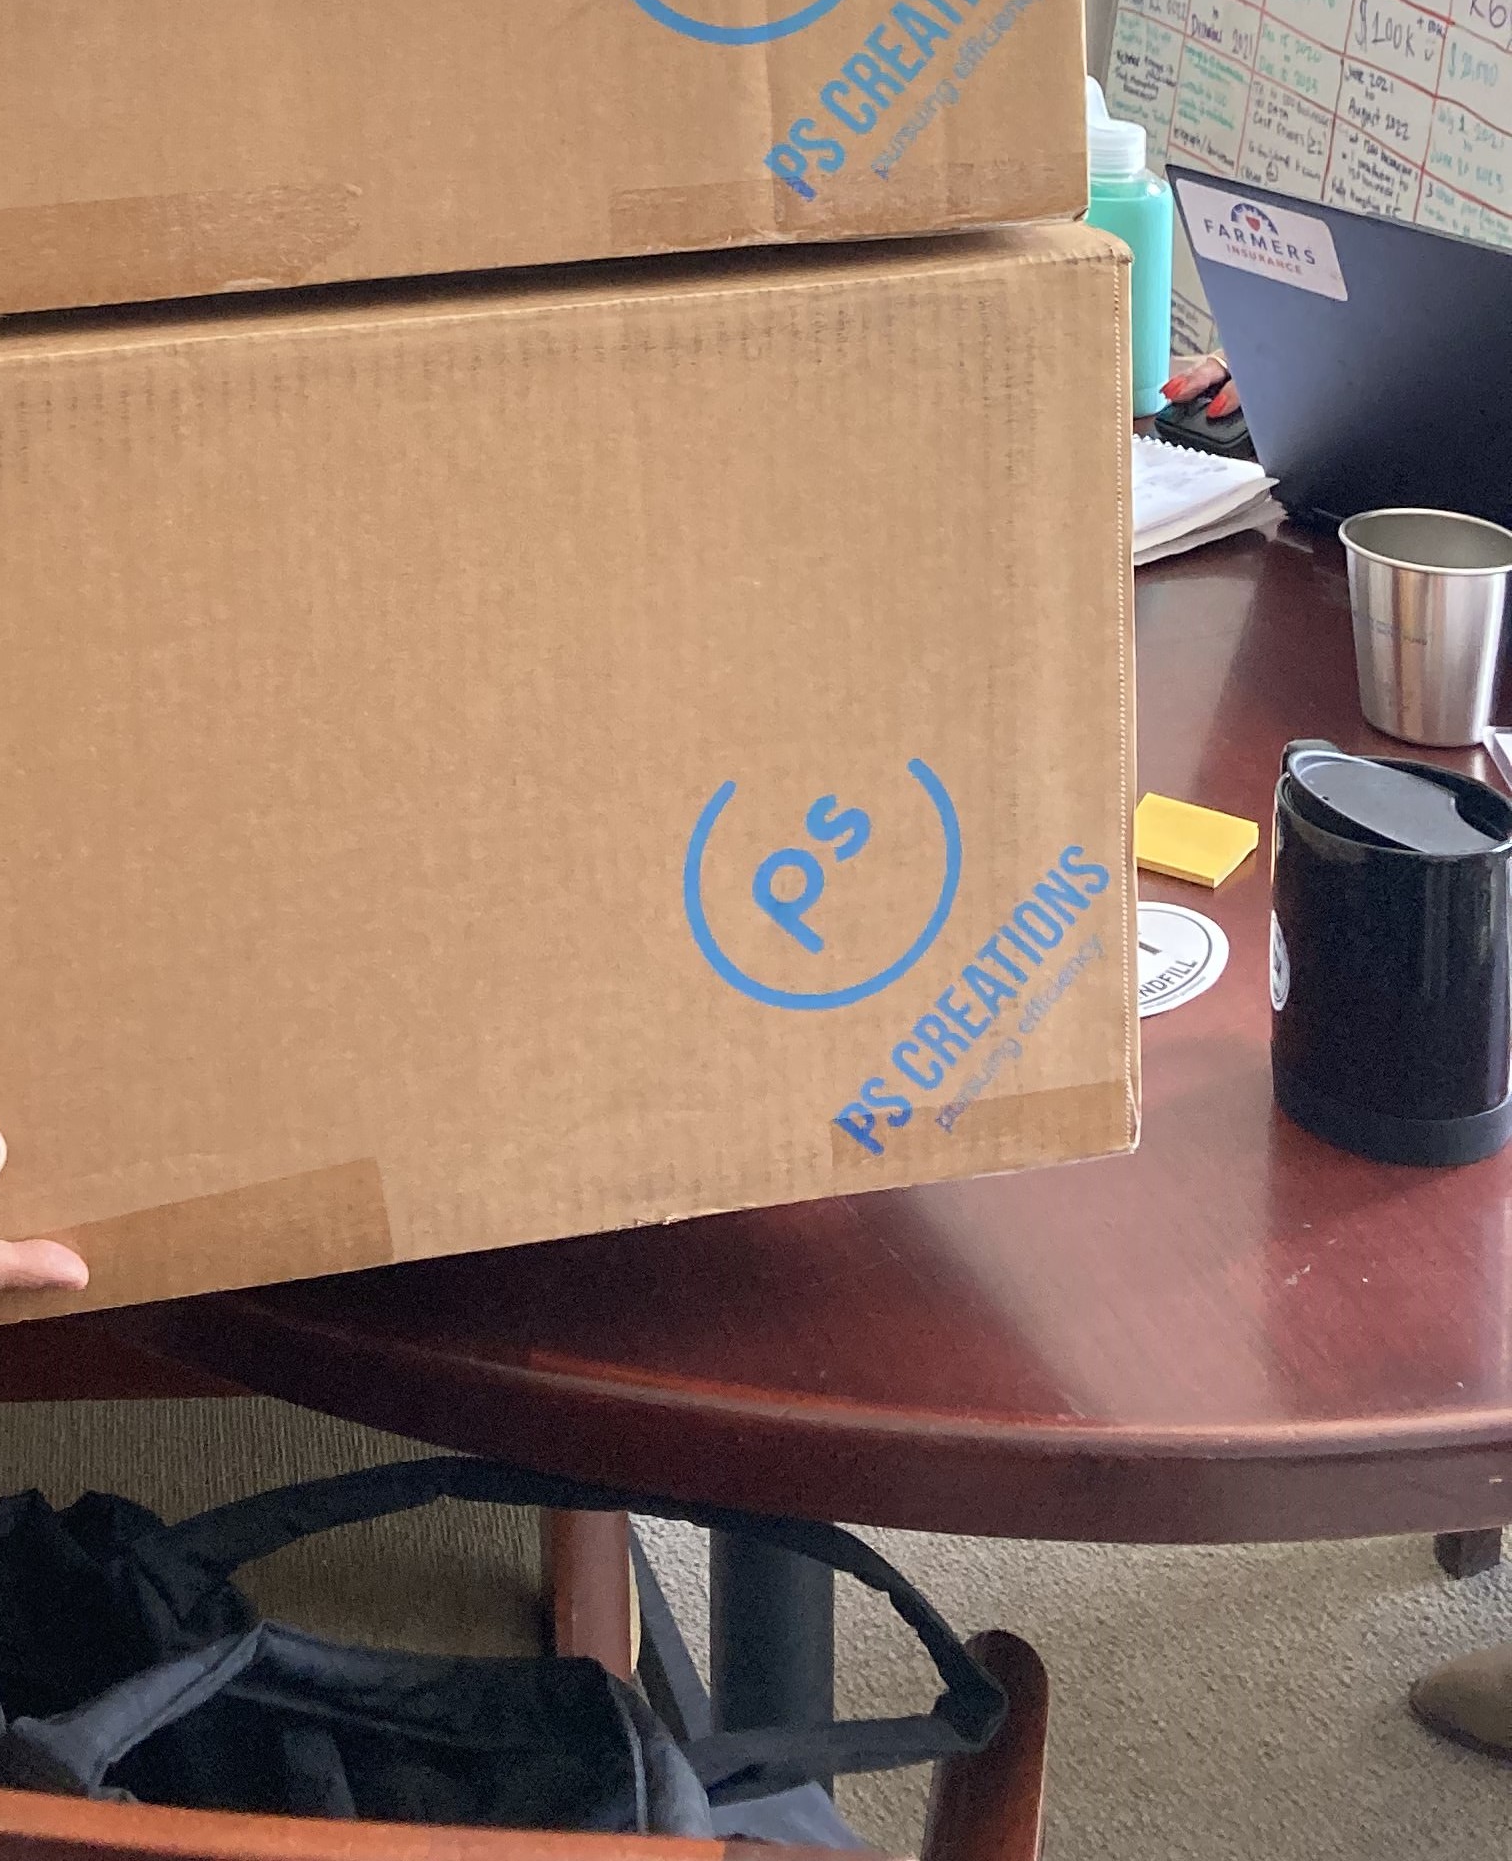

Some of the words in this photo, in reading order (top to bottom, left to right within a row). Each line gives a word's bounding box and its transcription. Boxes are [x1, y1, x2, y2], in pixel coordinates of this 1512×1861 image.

[763, 118, 846, 202] PS
[1203, 218, 1317, 266] FARMERS
[1226, 243, 1304, 276] INSURANCE
[832, 1077, 913, 1156] PS
[891, 845, 1111, 1091] CREATIONS
[1139, 959, 1198, 999] NDFILL
